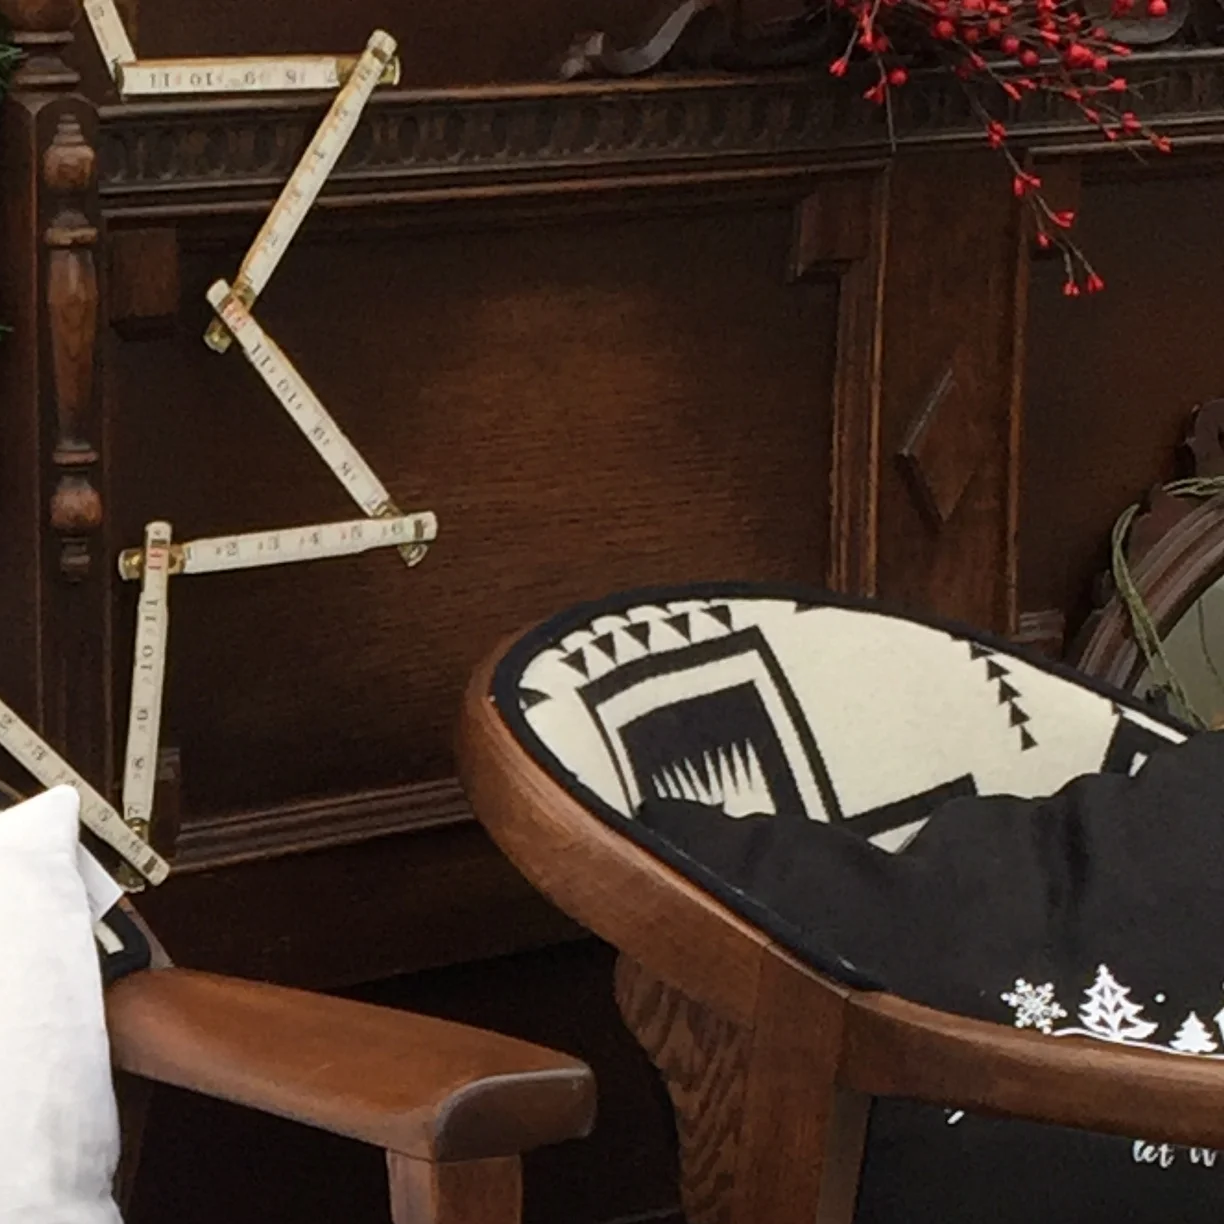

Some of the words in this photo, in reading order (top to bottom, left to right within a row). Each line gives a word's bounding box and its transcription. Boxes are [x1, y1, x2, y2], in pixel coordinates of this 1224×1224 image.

[149, 73, 170, 88] 11
[189, 72, 212, 86] 10
[145, 599, 158, 622] 11
[141, 644, 154, 671] 10
